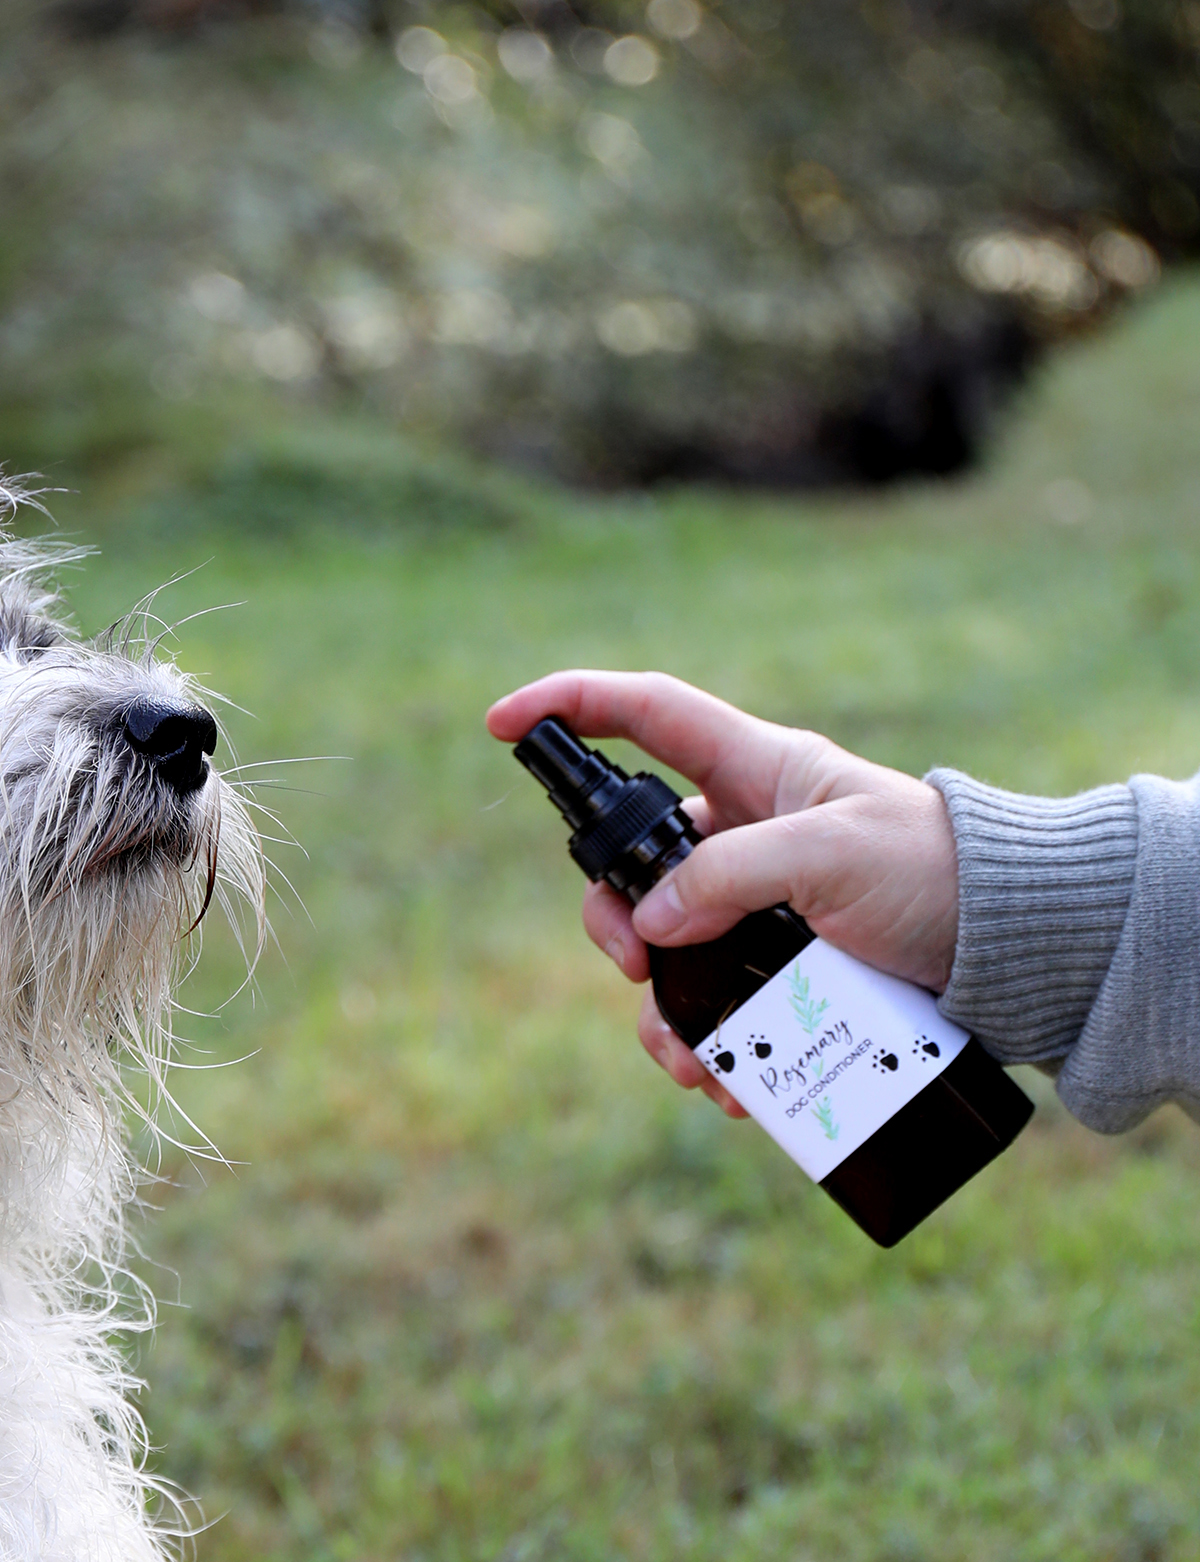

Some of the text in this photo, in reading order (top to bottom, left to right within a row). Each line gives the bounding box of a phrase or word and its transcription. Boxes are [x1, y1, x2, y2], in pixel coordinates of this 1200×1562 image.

[759, 1019, 853, 1099] Rosemary
[785, 1038, 874, 1119] DOG CONDITIONER
